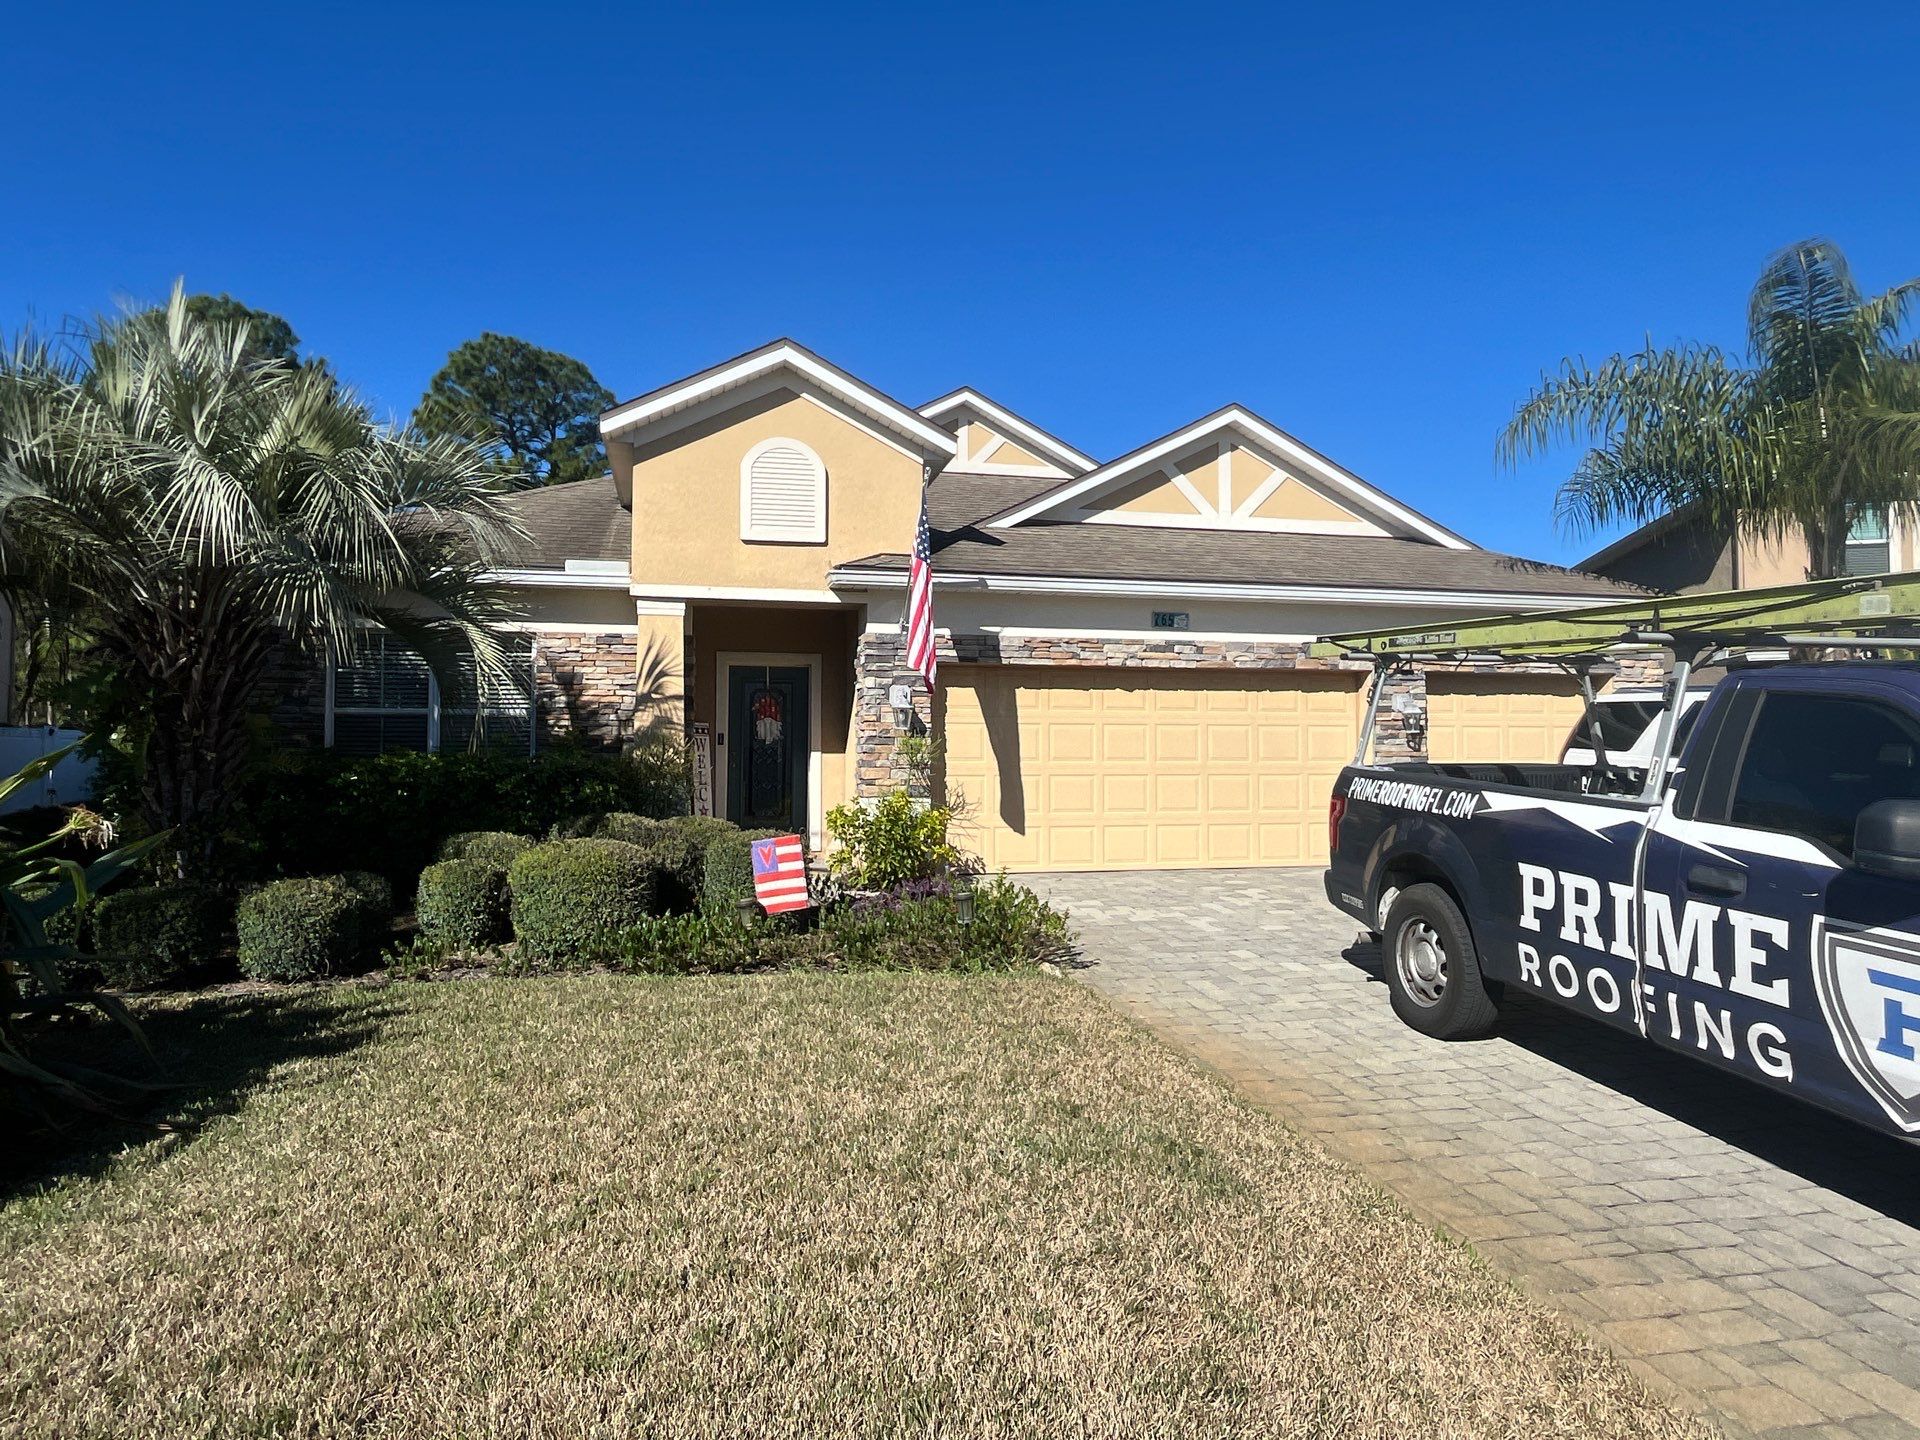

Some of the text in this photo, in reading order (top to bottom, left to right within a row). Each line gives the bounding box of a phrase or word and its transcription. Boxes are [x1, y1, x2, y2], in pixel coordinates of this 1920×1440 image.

[696, 738, 708, 801] WELC
[1347, 777, 1480, 820] PRIMEROOFINGFL.COM
[1517, 862, 1790, 1009] PRIME
[1518, 942, 1795, 1082] ROOFING
